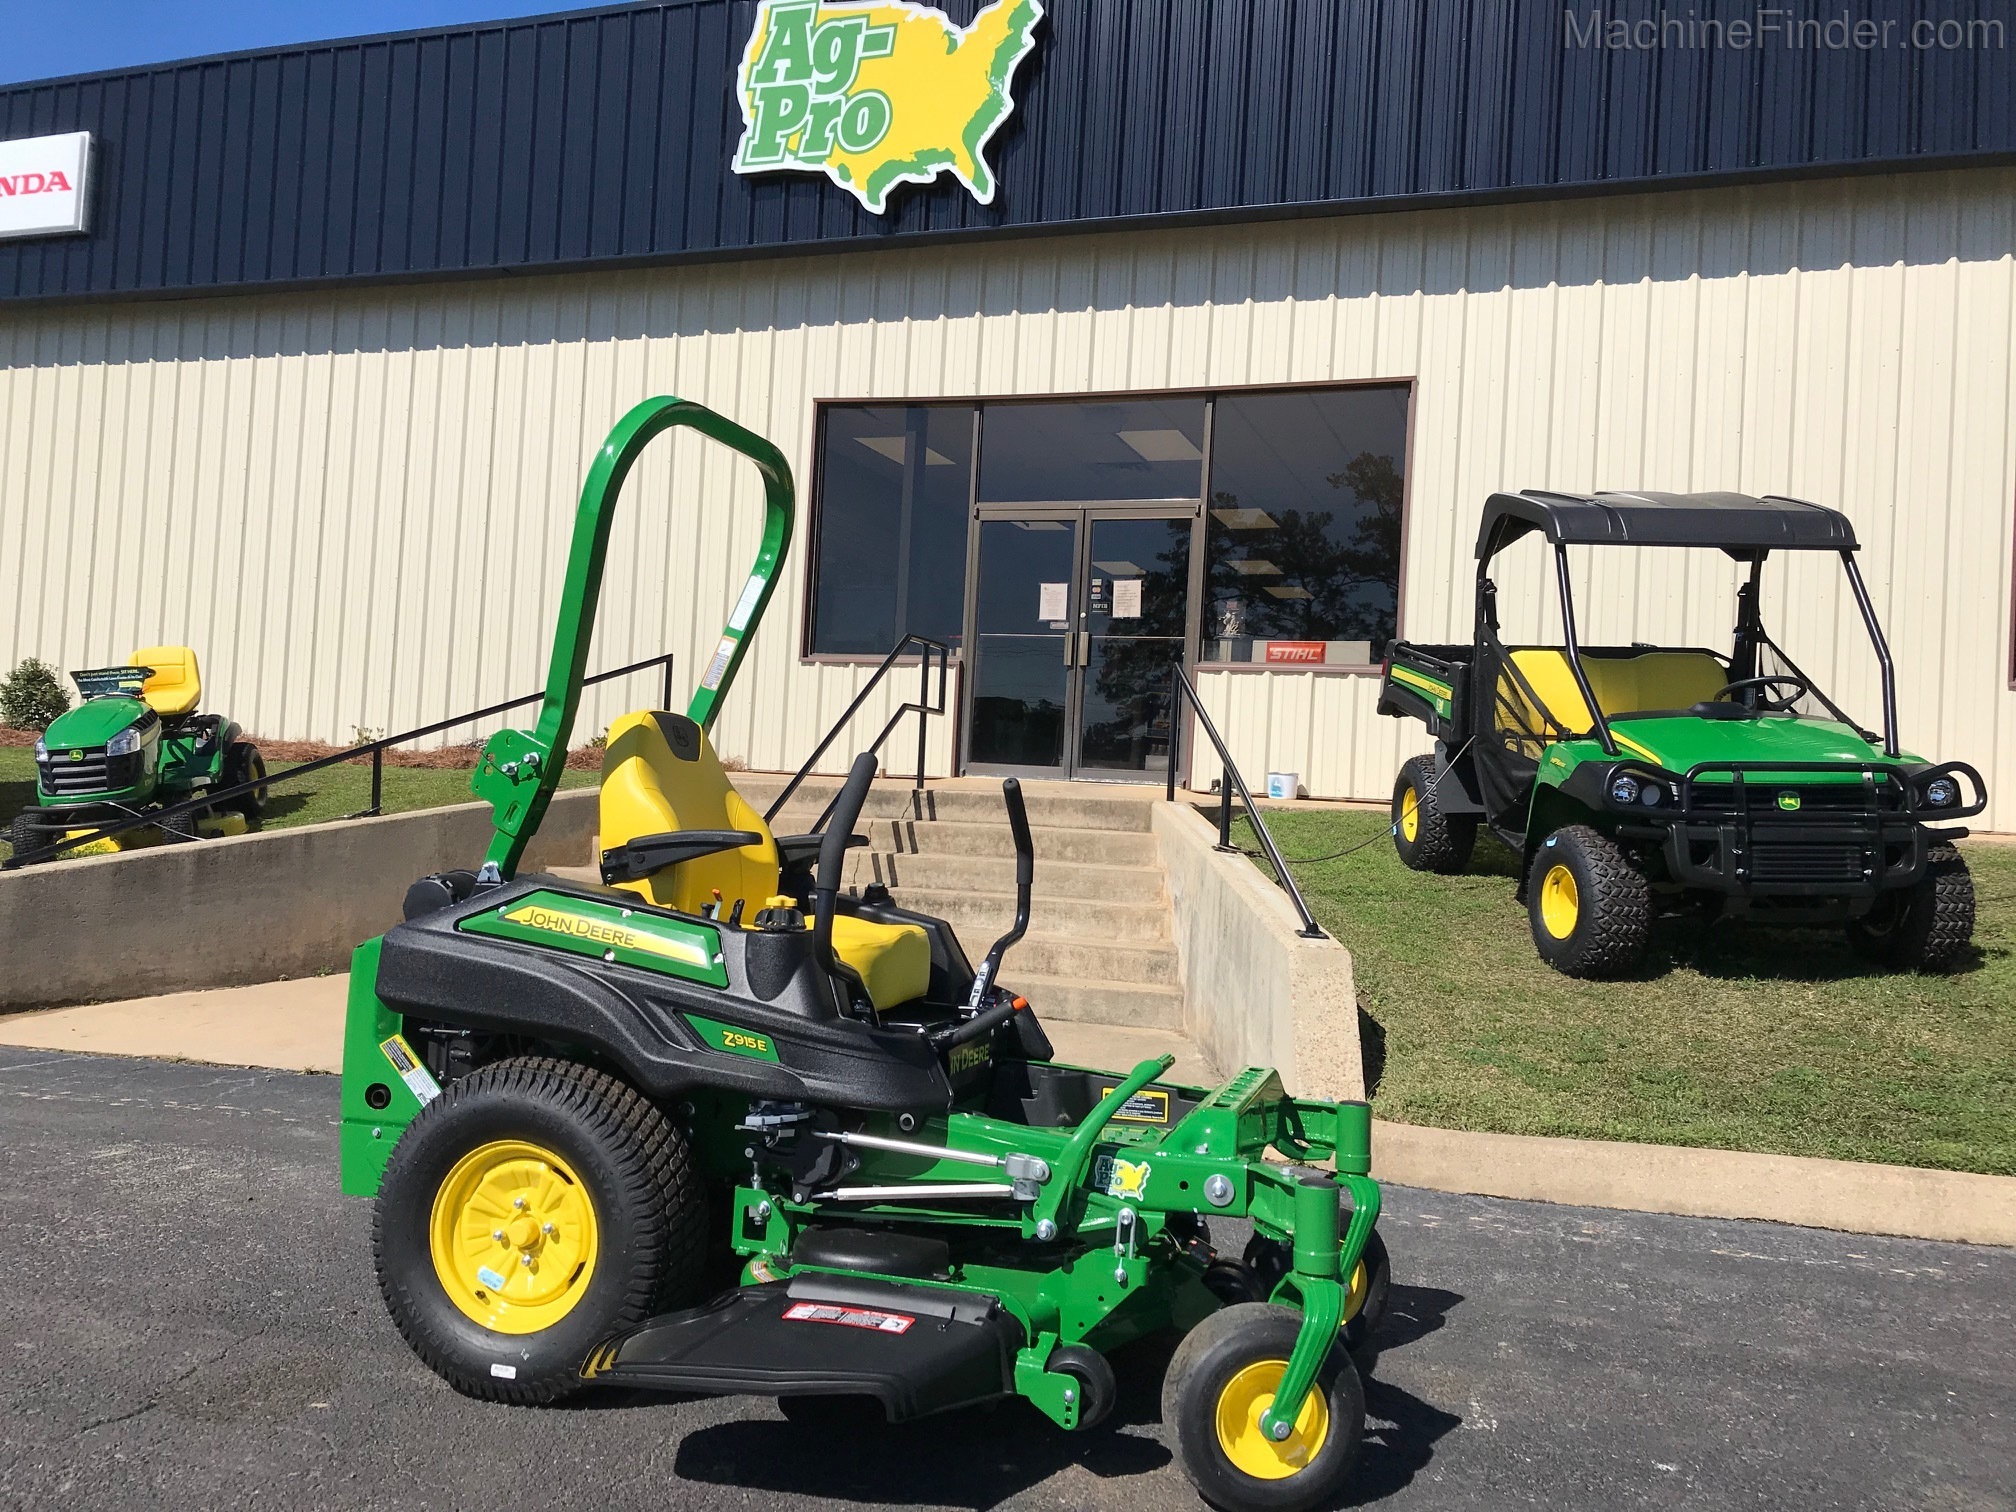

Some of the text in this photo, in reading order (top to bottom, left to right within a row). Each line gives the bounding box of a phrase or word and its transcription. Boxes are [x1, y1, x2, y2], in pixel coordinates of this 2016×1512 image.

[747, 2, 897, 96] Ag-
[742, 83, 893, 165] Pro
[1270, 648, 1319, 660] STIHL
[522, 909, 636, 947] JOHN DEERE
[721, 1029, 767, 1052] Z915E
[962, 1043, 990, 1071] DEERE
